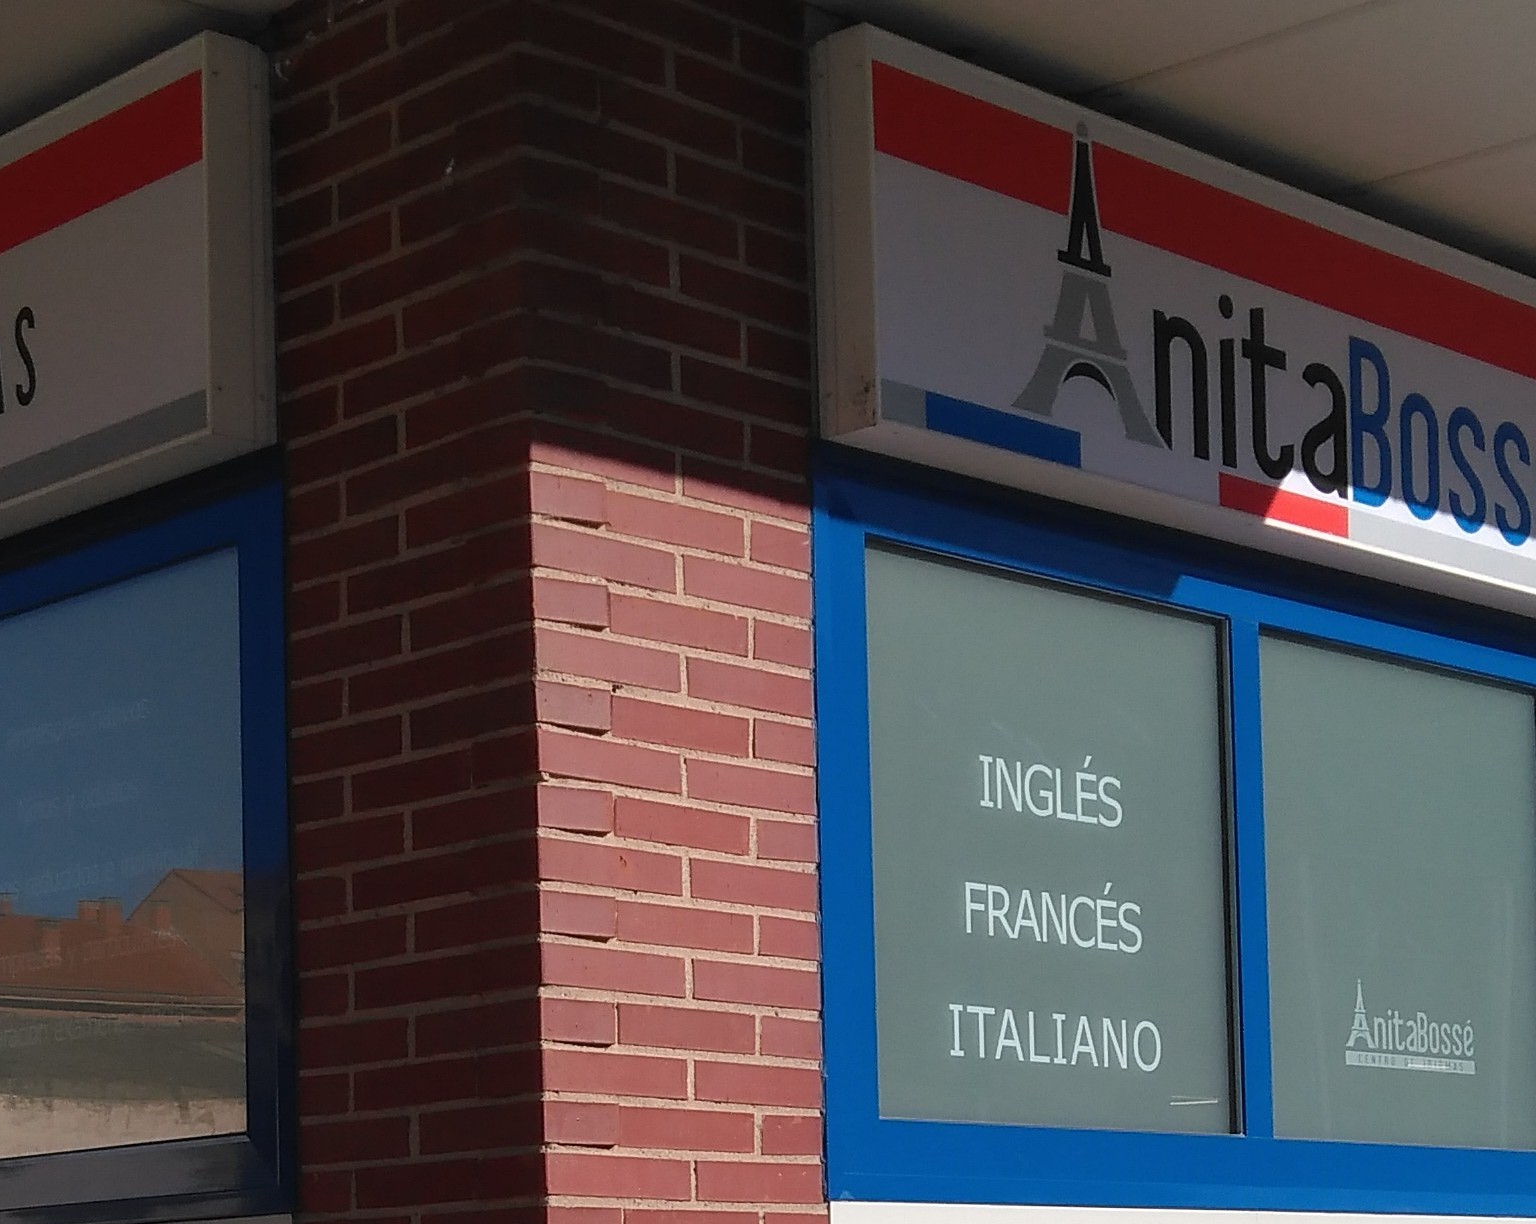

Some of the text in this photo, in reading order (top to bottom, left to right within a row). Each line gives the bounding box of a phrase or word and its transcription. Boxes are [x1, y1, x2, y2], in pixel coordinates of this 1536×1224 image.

[978, 754, 1124, 828] INGLÉS
[964, 881, 1144, 954] FRANCÉS
[948, 1002, 1163, 1073] ITALIANO
